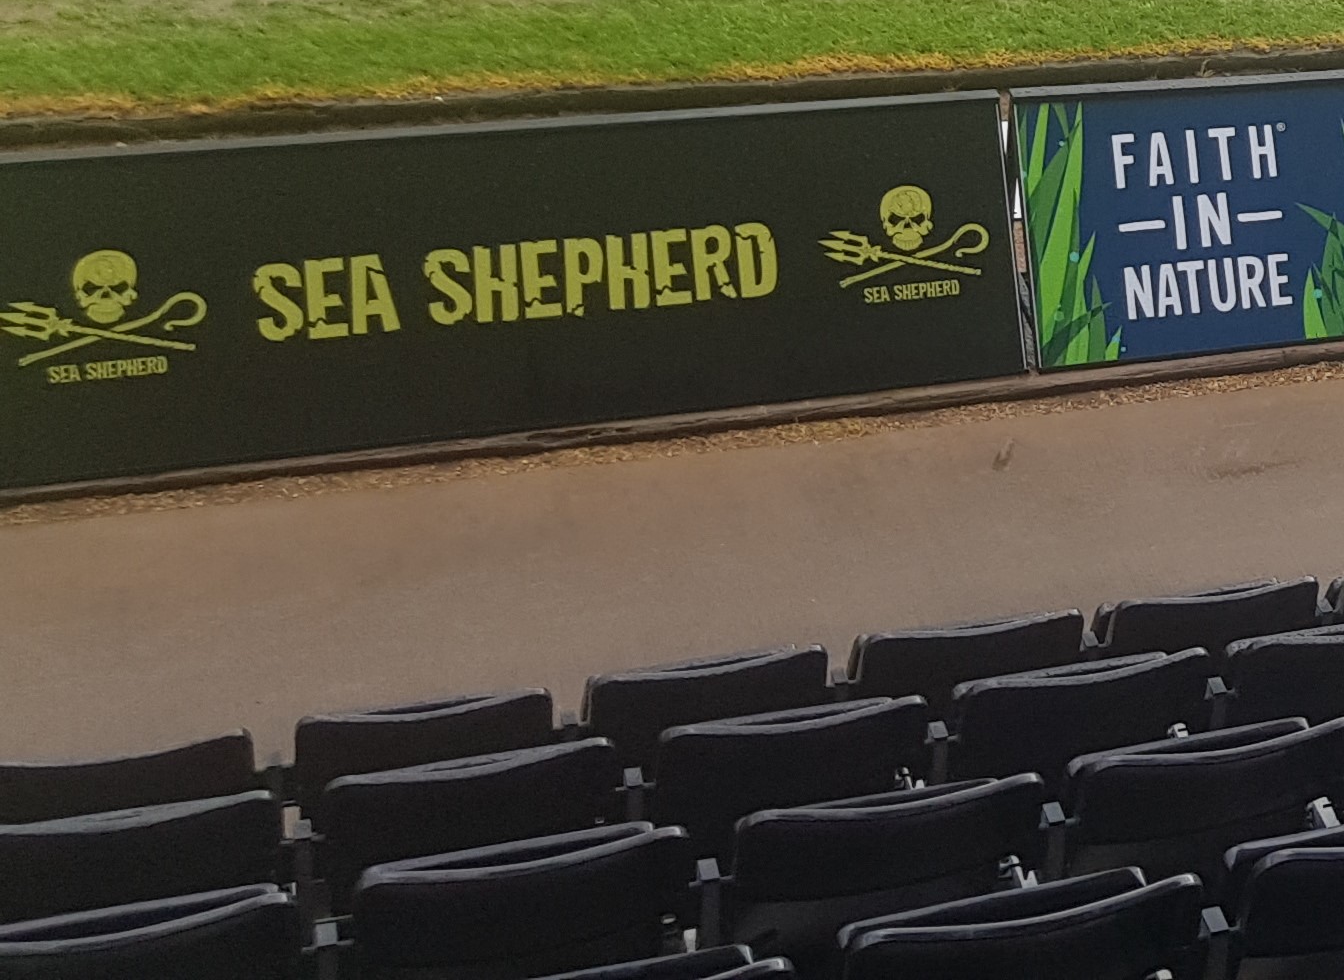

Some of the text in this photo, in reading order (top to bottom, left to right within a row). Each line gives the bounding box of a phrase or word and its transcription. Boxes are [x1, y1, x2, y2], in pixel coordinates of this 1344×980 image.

[252, 222, 779, 343] SEA SHEPHERD
[863, 278, 961, 304] SEA SHEPHERD
[1123, 253, 1293, 320] NATURE
[48, 355, 169, 385] SEA SHEPHERD
